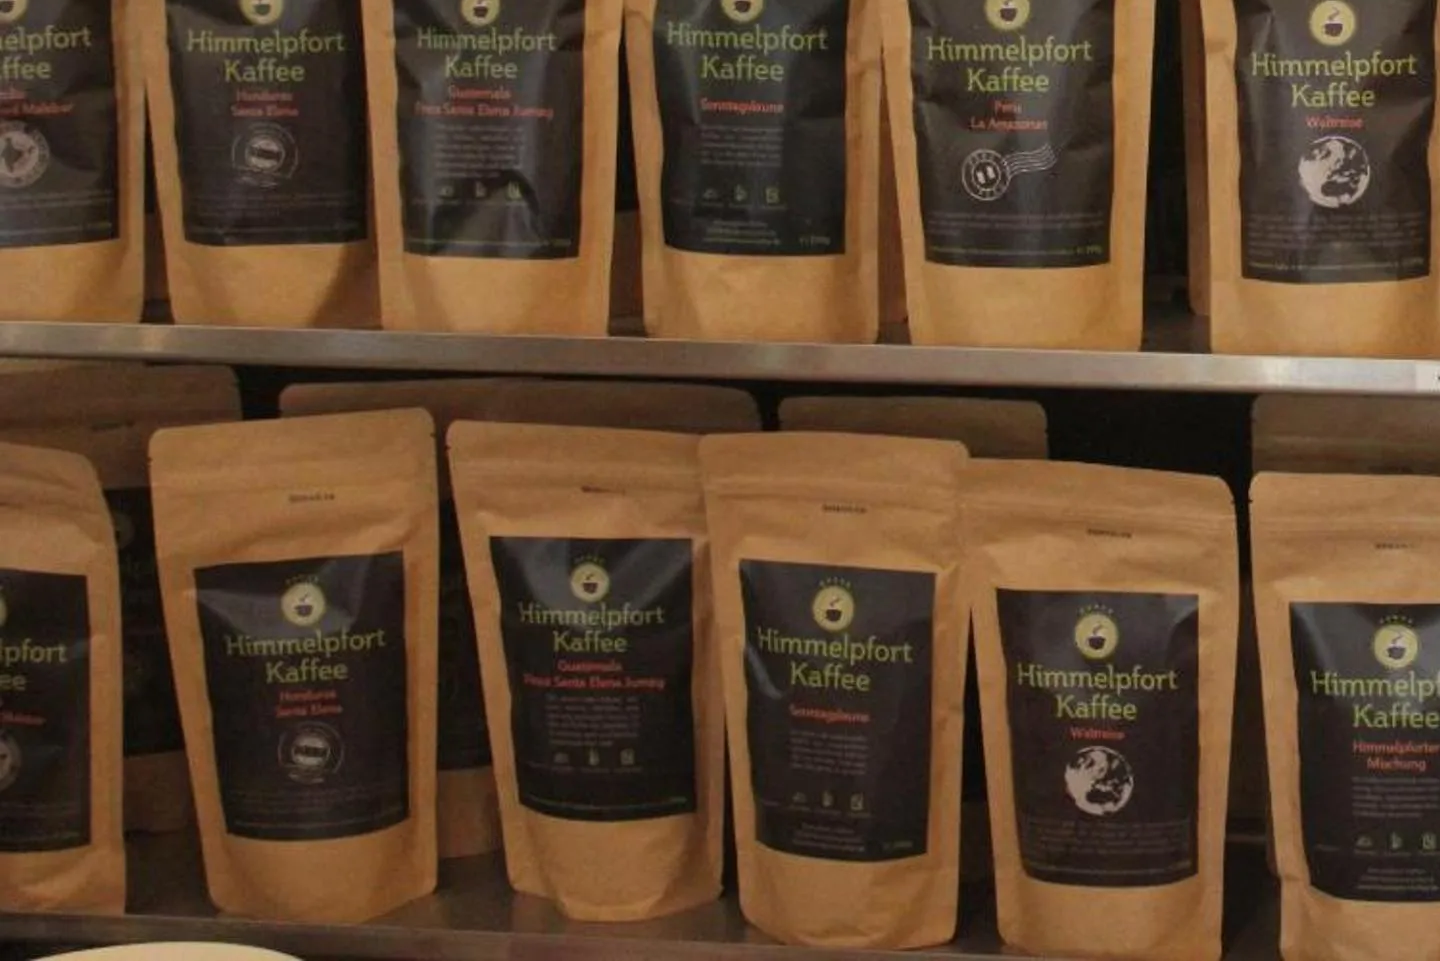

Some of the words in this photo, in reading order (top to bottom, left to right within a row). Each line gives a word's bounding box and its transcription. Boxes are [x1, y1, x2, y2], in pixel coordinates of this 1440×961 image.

[0, 25, 92, 53] elpfort
[186, 29, 346, 55] Himmelpfort
[415, 27, 558, 53] Himmelpfort
[665, 21, 829, 55] Himmelpfort
[926, 35, 1093, 65] Himmelpfort
[224, 59, 306, 82] Kaffee
[443, 55, 519, 79] Kaffee
[700, 54, 785, 82] Kaffee
[966, 66, 1051, 93] Kaffee
[1250, 50, 1419, 81] Himmelpfort
[1290, 79, 1377, 108] Kaffee
[518, 601, 666, 630] Himmelpfort
[226, 628, 386, 658] Himmelpfort
[552, 630, 628, 653] Kaffee
[757, 625, 913, 665] Himmelpfort
[265, 659, 350, 685] Kaffee
[789, 660, 872, 693] Kaffee
[1016, 662, 1179, 695] Himmelpfort
[1055, 694, 1138, 721] Kaffee
